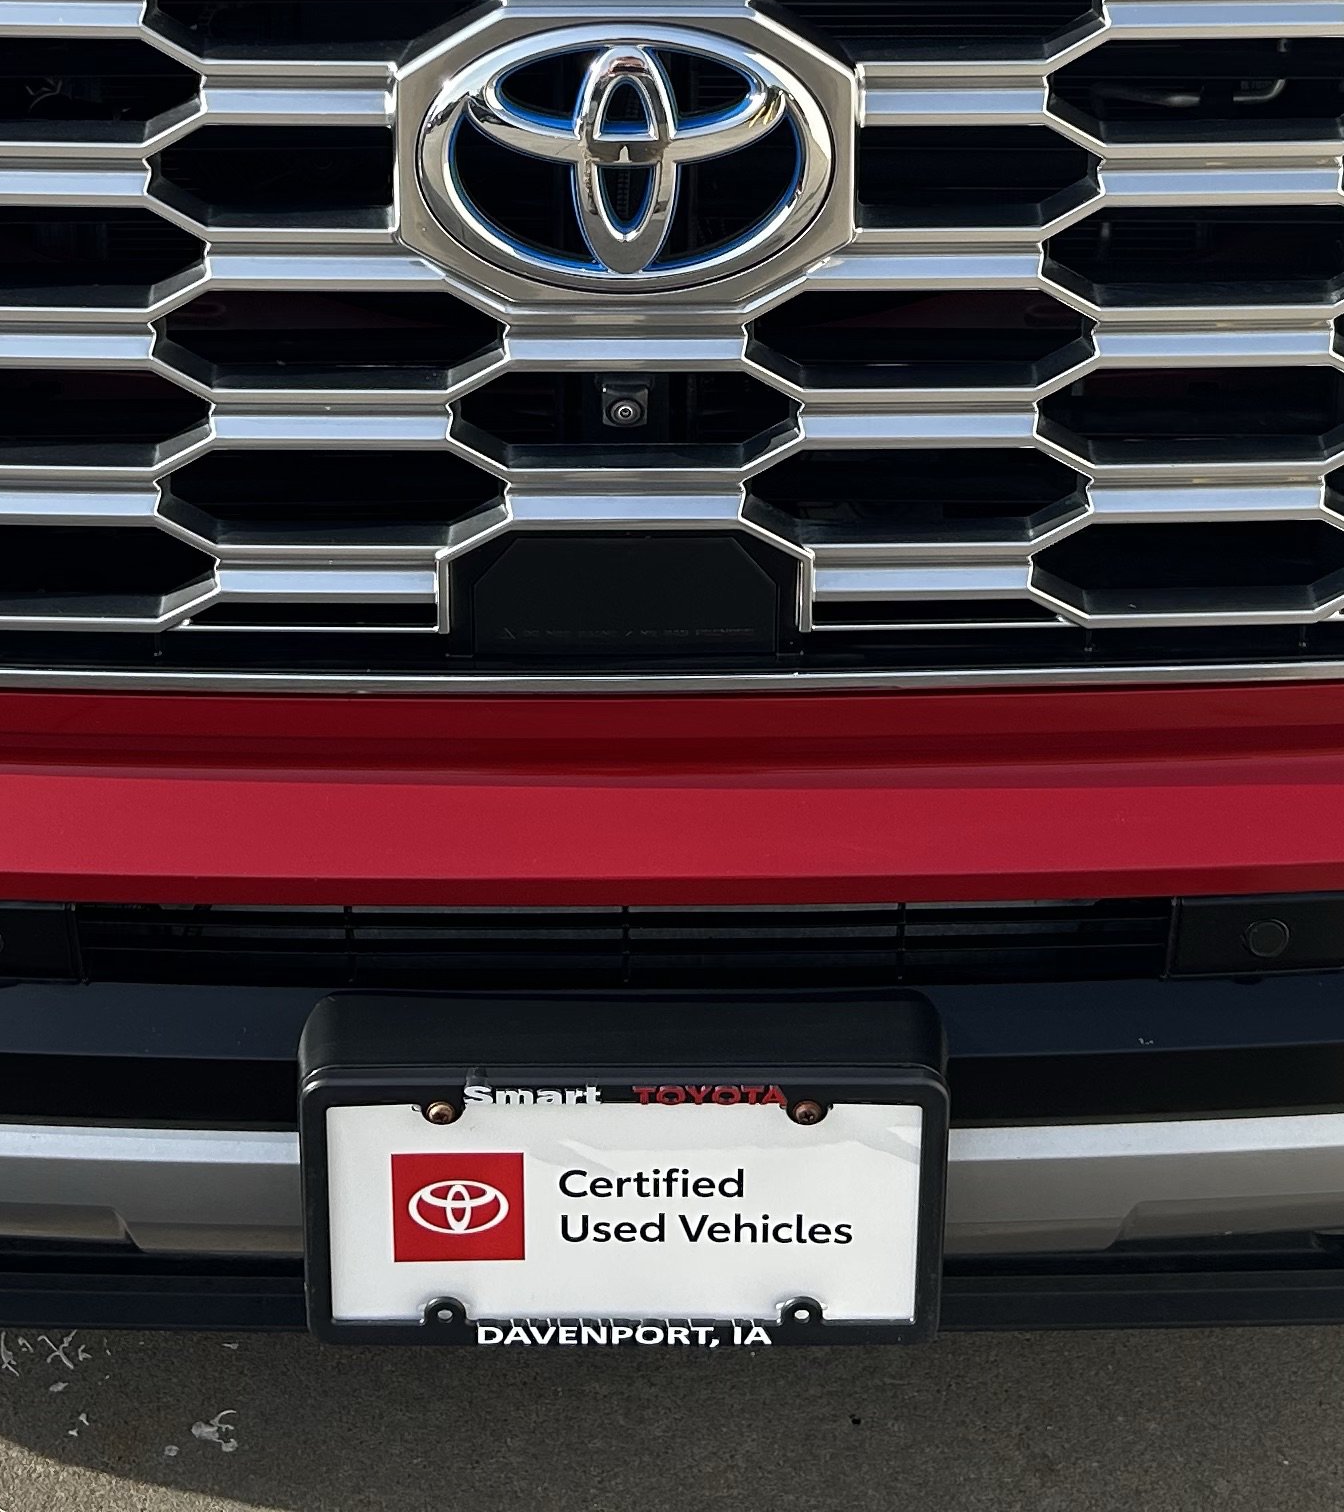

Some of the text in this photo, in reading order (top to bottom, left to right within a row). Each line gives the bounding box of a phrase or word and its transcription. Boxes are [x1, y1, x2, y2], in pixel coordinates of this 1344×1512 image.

[463, 1082, 789, 1107] Smart TOYOTA
[558, 1168, 745, 1198] Certified
[560, 1213, 854, 1244] Used Vehicles
[476, 1325, 773, 1348] DAVENPORT, IA
